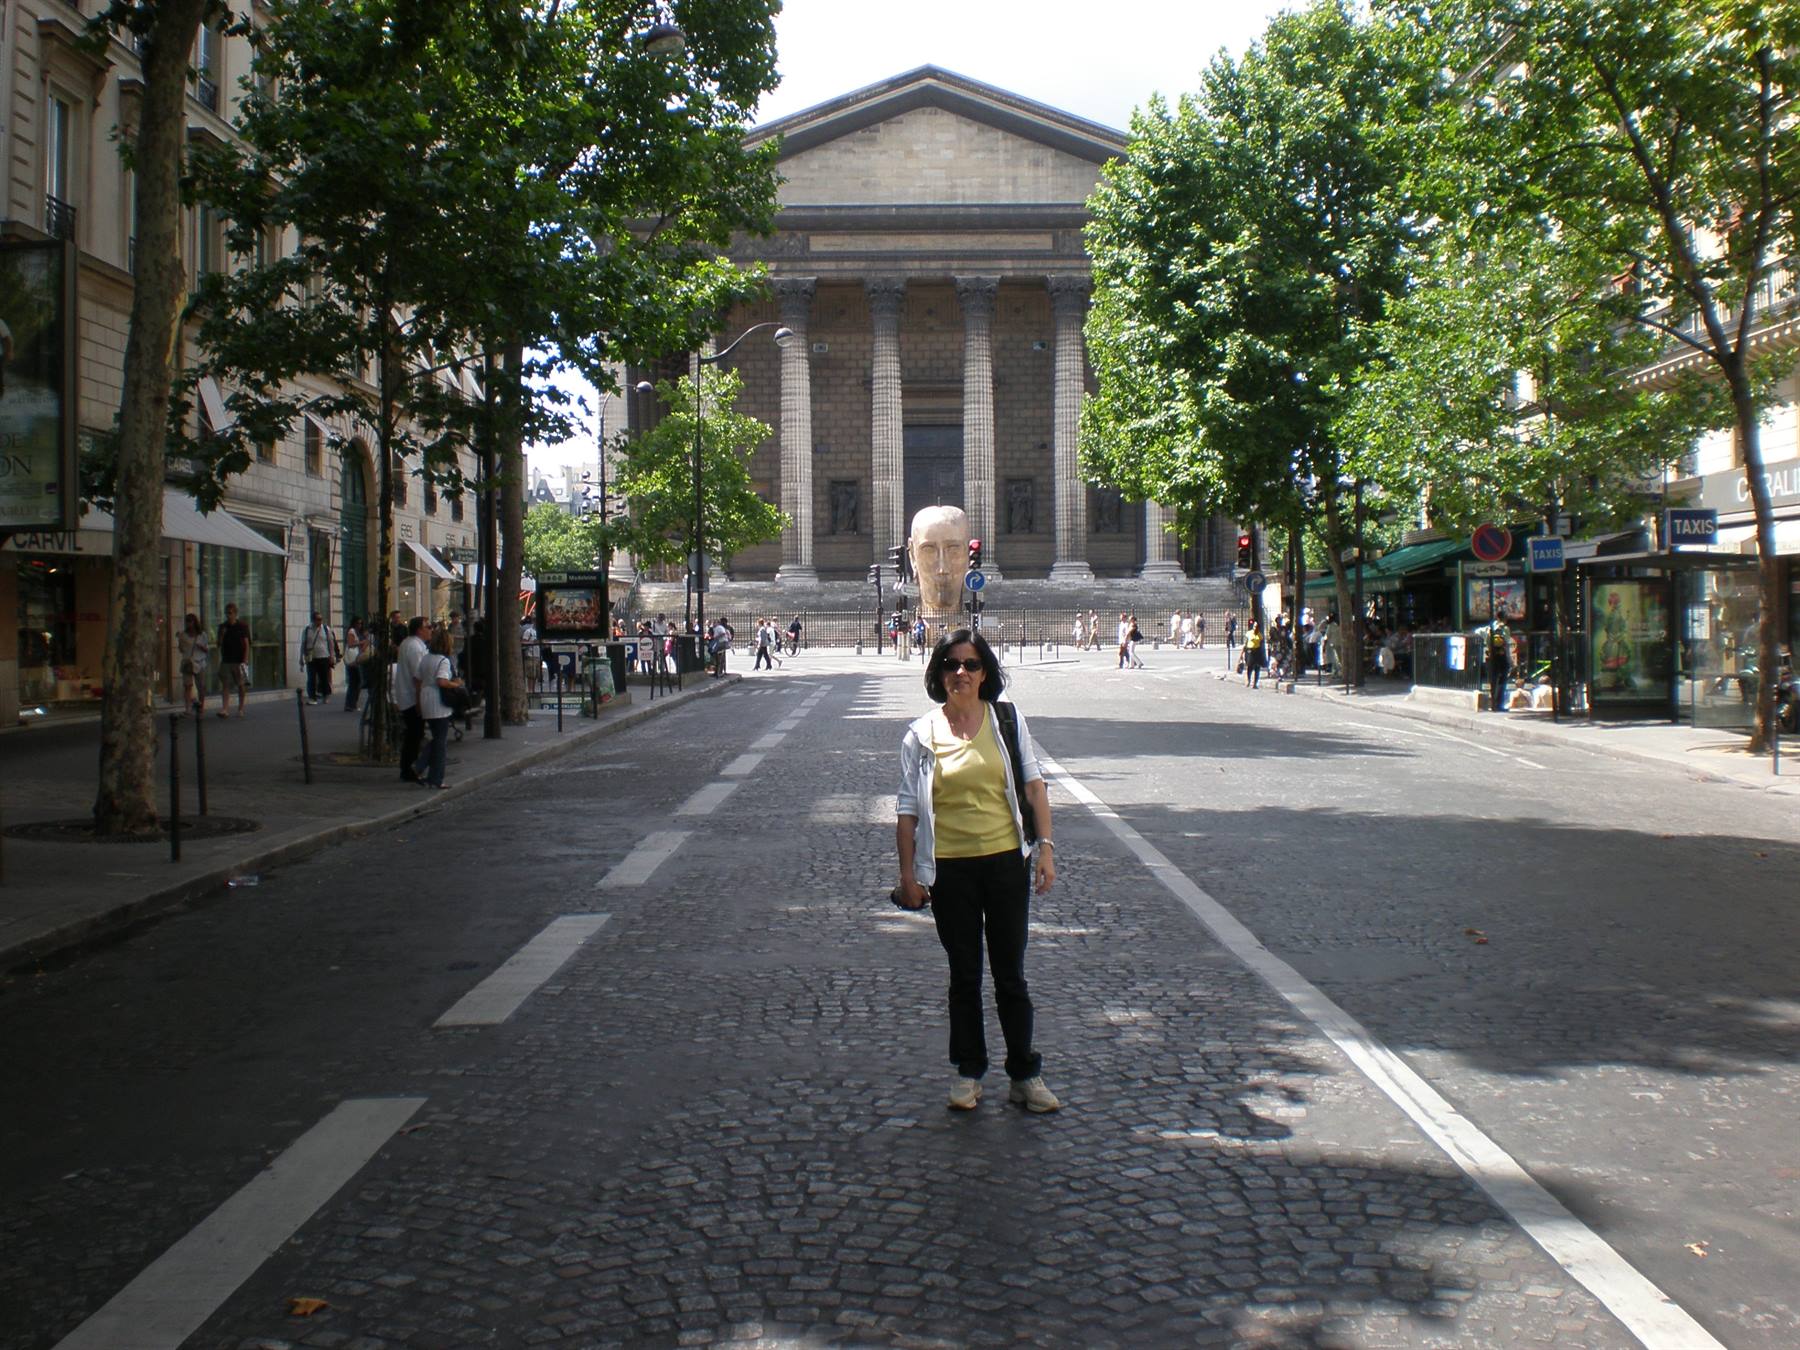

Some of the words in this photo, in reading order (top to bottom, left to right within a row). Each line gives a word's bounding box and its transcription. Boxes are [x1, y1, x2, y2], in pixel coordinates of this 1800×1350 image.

[1736, 467, 1800, 502] CRALI
[1674, 518, 1715, 535] TAXIS
[13, 530, 83, 551] CARVIL
[1533, 548, 1562, 560] TAXIS
